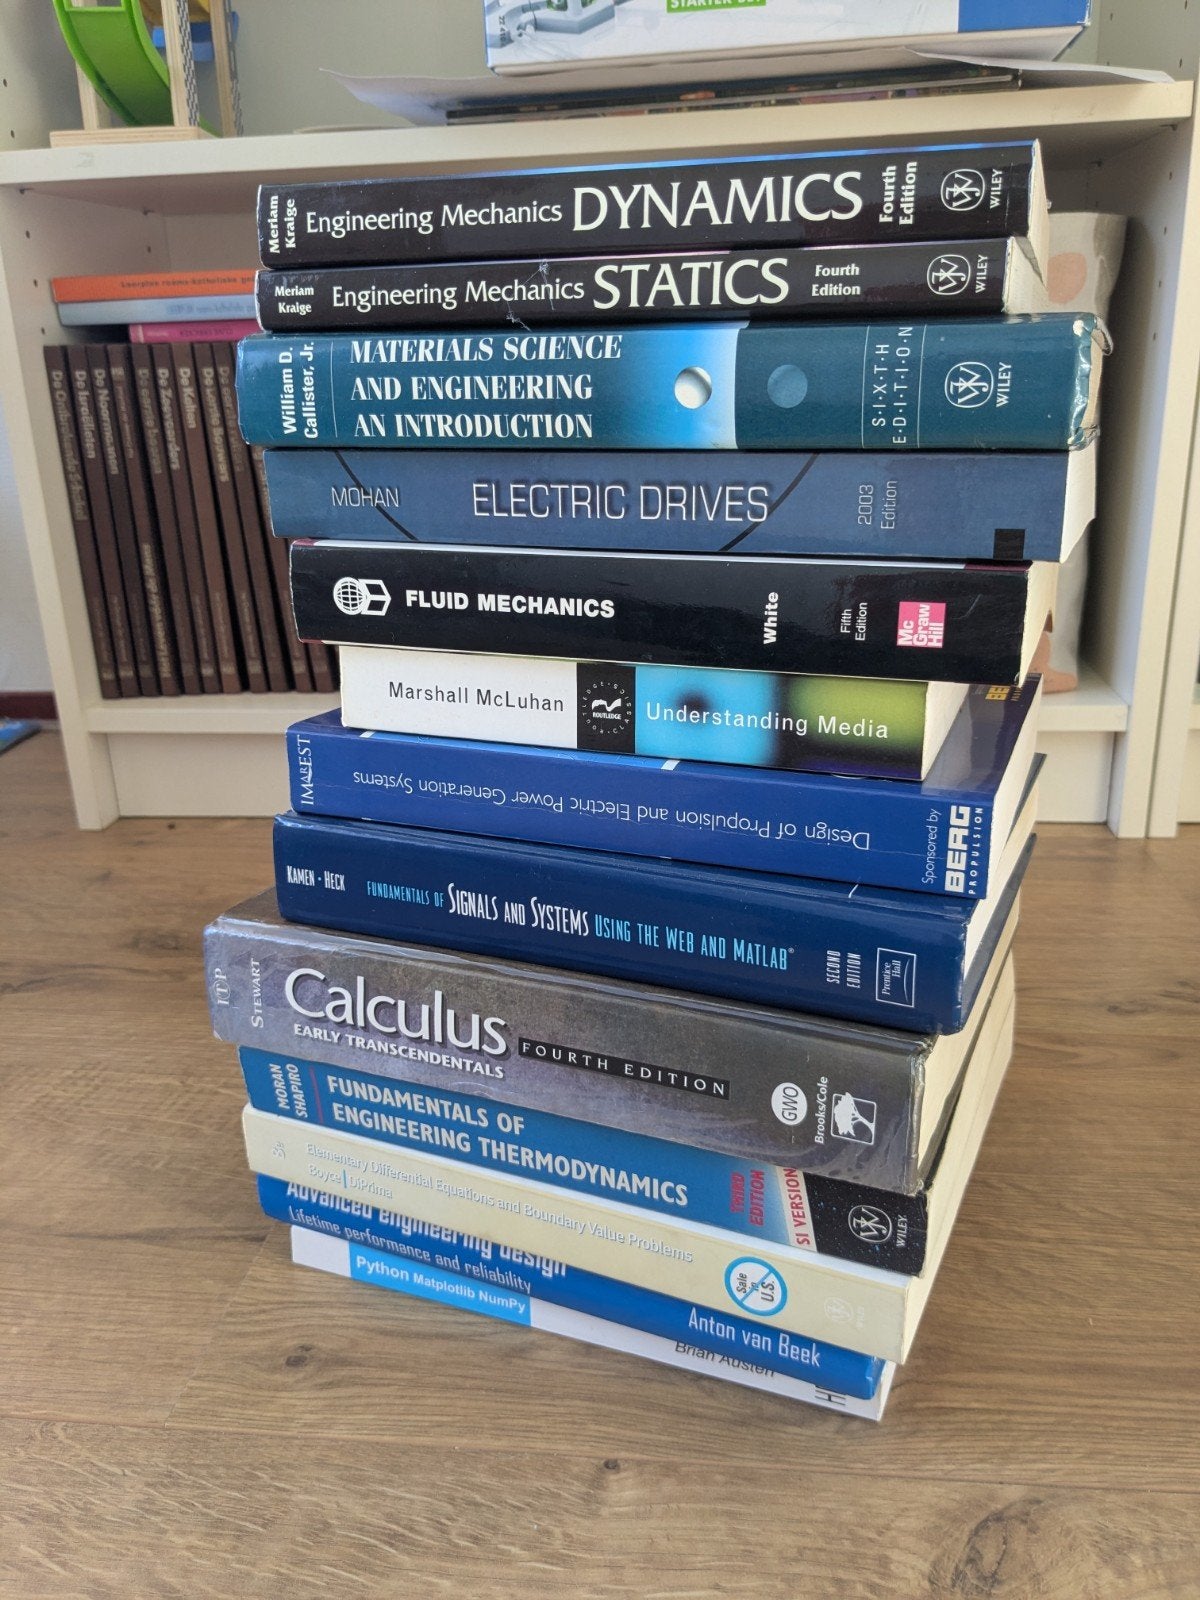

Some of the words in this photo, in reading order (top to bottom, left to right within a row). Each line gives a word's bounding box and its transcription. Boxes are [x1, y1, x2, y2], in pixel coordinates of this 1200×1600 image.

[306, 207, 433, 239] Engineering
[440, 199, 563, 228] Mechanics
[573, 170, 863, 232] DYNAMICS
[879, 165, 897, 223] Fourth
[899, 161, 918, 225] Edition
[989, 168, 1003, 209] WILEY
[269, 195, 280, 254] Meriam
[285, 198, 298, 249] Kraige
[332, 282, 458, 313] Engineering
[464, 276, 585, 303] Mechanics
[593, 257, 790, 310] STATICS
[815, 263, 860, 277] Fourth
[975, 254, 988, 293] WILEY
[274, 285, 315, 298] Meriam
[278, 301, 312, 315] Kraige
[811, 283, 861, 297] Edition
[278, 347, 293, 363] D.
[299, 341, 315, 361] Jr.
[350, 336, 494, 364] MATERIALS
[503, 334, 623, 361] SCIENCE
[279, 367, 297, 436] William
[301, 366, 319, 439] Callister,
[351, 376, 402, 401] AND
[411, 373, 593, 401] ENGINEERING
[996, 361, 1013, 408] WILEY
[354, 413, 387, 437] AN
[395, 413, 593, 439] INTRODUCTION
[331, 486, 400, 508] MOHAN
[472, 482, 626, 520] ELECTRIC
[640, 485, 769, 523] DRIVES
[857, 483, 875, 526] 2003
[880, 479, 898, 530] Edition
[405, 589, 470, 611] FLUID
[477, 594, 616, 619] MECHANICS
[763, 591, 779, 645] White
[840, 608, 852, 634] Fifth
[855, 602, 868, 641] Edition
[897, 620, 914, 646] Mc
[912, 604, 930, 646] Graw
[928, 622, 944, 648] Hill
[388, 681, 469, 705] Marshall
[476, 688, 564, 712] McLuhan
[592, 711, 622, 720] ROUTLEDGE
[646, 702, 808, 737] Understanding
[817, 715, 889, 739] Media
[353, 771, 413, 794] Systems
[418, 778, 506, 805] Generation
[511, 791, 563, 813] Power
[570, 797, 630, 821] Electric
[637, 805, 669, 822] and
[926, 808, 942, 822] by
[676, 811, 770, 839] Propulsion
[775, 822, 797, 840] of
[804, 822, 870, 851] Design
[921, 825, 938, 884] Sponsored
[968, 807, 984, 895] PROPULSION
[287, 865, 315, 887] KAMEN
[324, 870, 346, 892] HECK
[367, 880, 430, 905] FUNDAMENTALS
[434, 891, 445, 908] OF
[448, 882, 499, 921] SIGNALS
[503, 901, 526, 926] AND
[530, 896, 590, 937] SYSTEMS
[594, 914, 631, 943] USING
[636, 923, 659, 948] THE
[665, 926, 694, 953] WEB
[700, 934, 726, 959] AND
[826, 950, 841, 984] SECOND
[846, 952, 861, 989] EDITION
[882, 962, 892, 995] Prentice
[892, 960, 902, 978] Hall
[251, 958, 264, 1029] STEWART
[285, 968, 508, 1056] Calculus
[294, 1023, 341, 1044] EARLY
[345, 1034, 504, 1079] TRANSCENDENTALS
[522, 1041, 609, 1071] FOURTH
[624, 1063, 725, 1097] EDITION
[273, 1064, 290, 1111] MORAN
[287, 1064, 308, 1118] SHAPIRO
[327, 1075, 489, 1128] FUNDAMENTALS
[497, 1113, 525, 1135] OF
[781, 1086, 799, 1122] GWO
[814, 1076, 828, 1144] Brooks/Cole
[308, 1163, 342, 1184] Boyce
[332, 1104, 471, 1153] ENGINEERING
[478, 1136, 688, 1206] THERMODYNAMICS
[306, 1143, 368, 1173] Elementary
[370, 1160, 433, 1190] Differential
[436, 1180, 495, 1207] Equations
[497, 1200, 521, 1214] and
[524, 1203, 585, 1236] Boundary
[588, 1219, 625, 1245] Value
[628, 1231, 694, 1263] Problems
[730, 1172, 746, 1213] THIRD
[750, 1169, 766, 1227] EDITION
[783, 1168, 807, 1228] VERSION
[796, 1233, 811, 1246] SI
[896, 1214, 908, 1247] WILEY
[288, 1205, 341, 1234] Lifetime
[344, 1223, 431, 1262] performance
[435, 1253, 461, 1271] and
[465, 1262, 532, 1295] reliability
[356, 1255, 410, 1283] Python
[413, 1272, 476, 1299] Matplotlib
[478, 1290, 526, 1314] NumPy
[736, 1272, 747, 1294] Sale
[760, 1280, 775, 1303] U.S.
[688, 1307, 736, 1342] Anton
[742, 1329, 772, 1353] van
[778, 1333, 821, 1368] Beek
